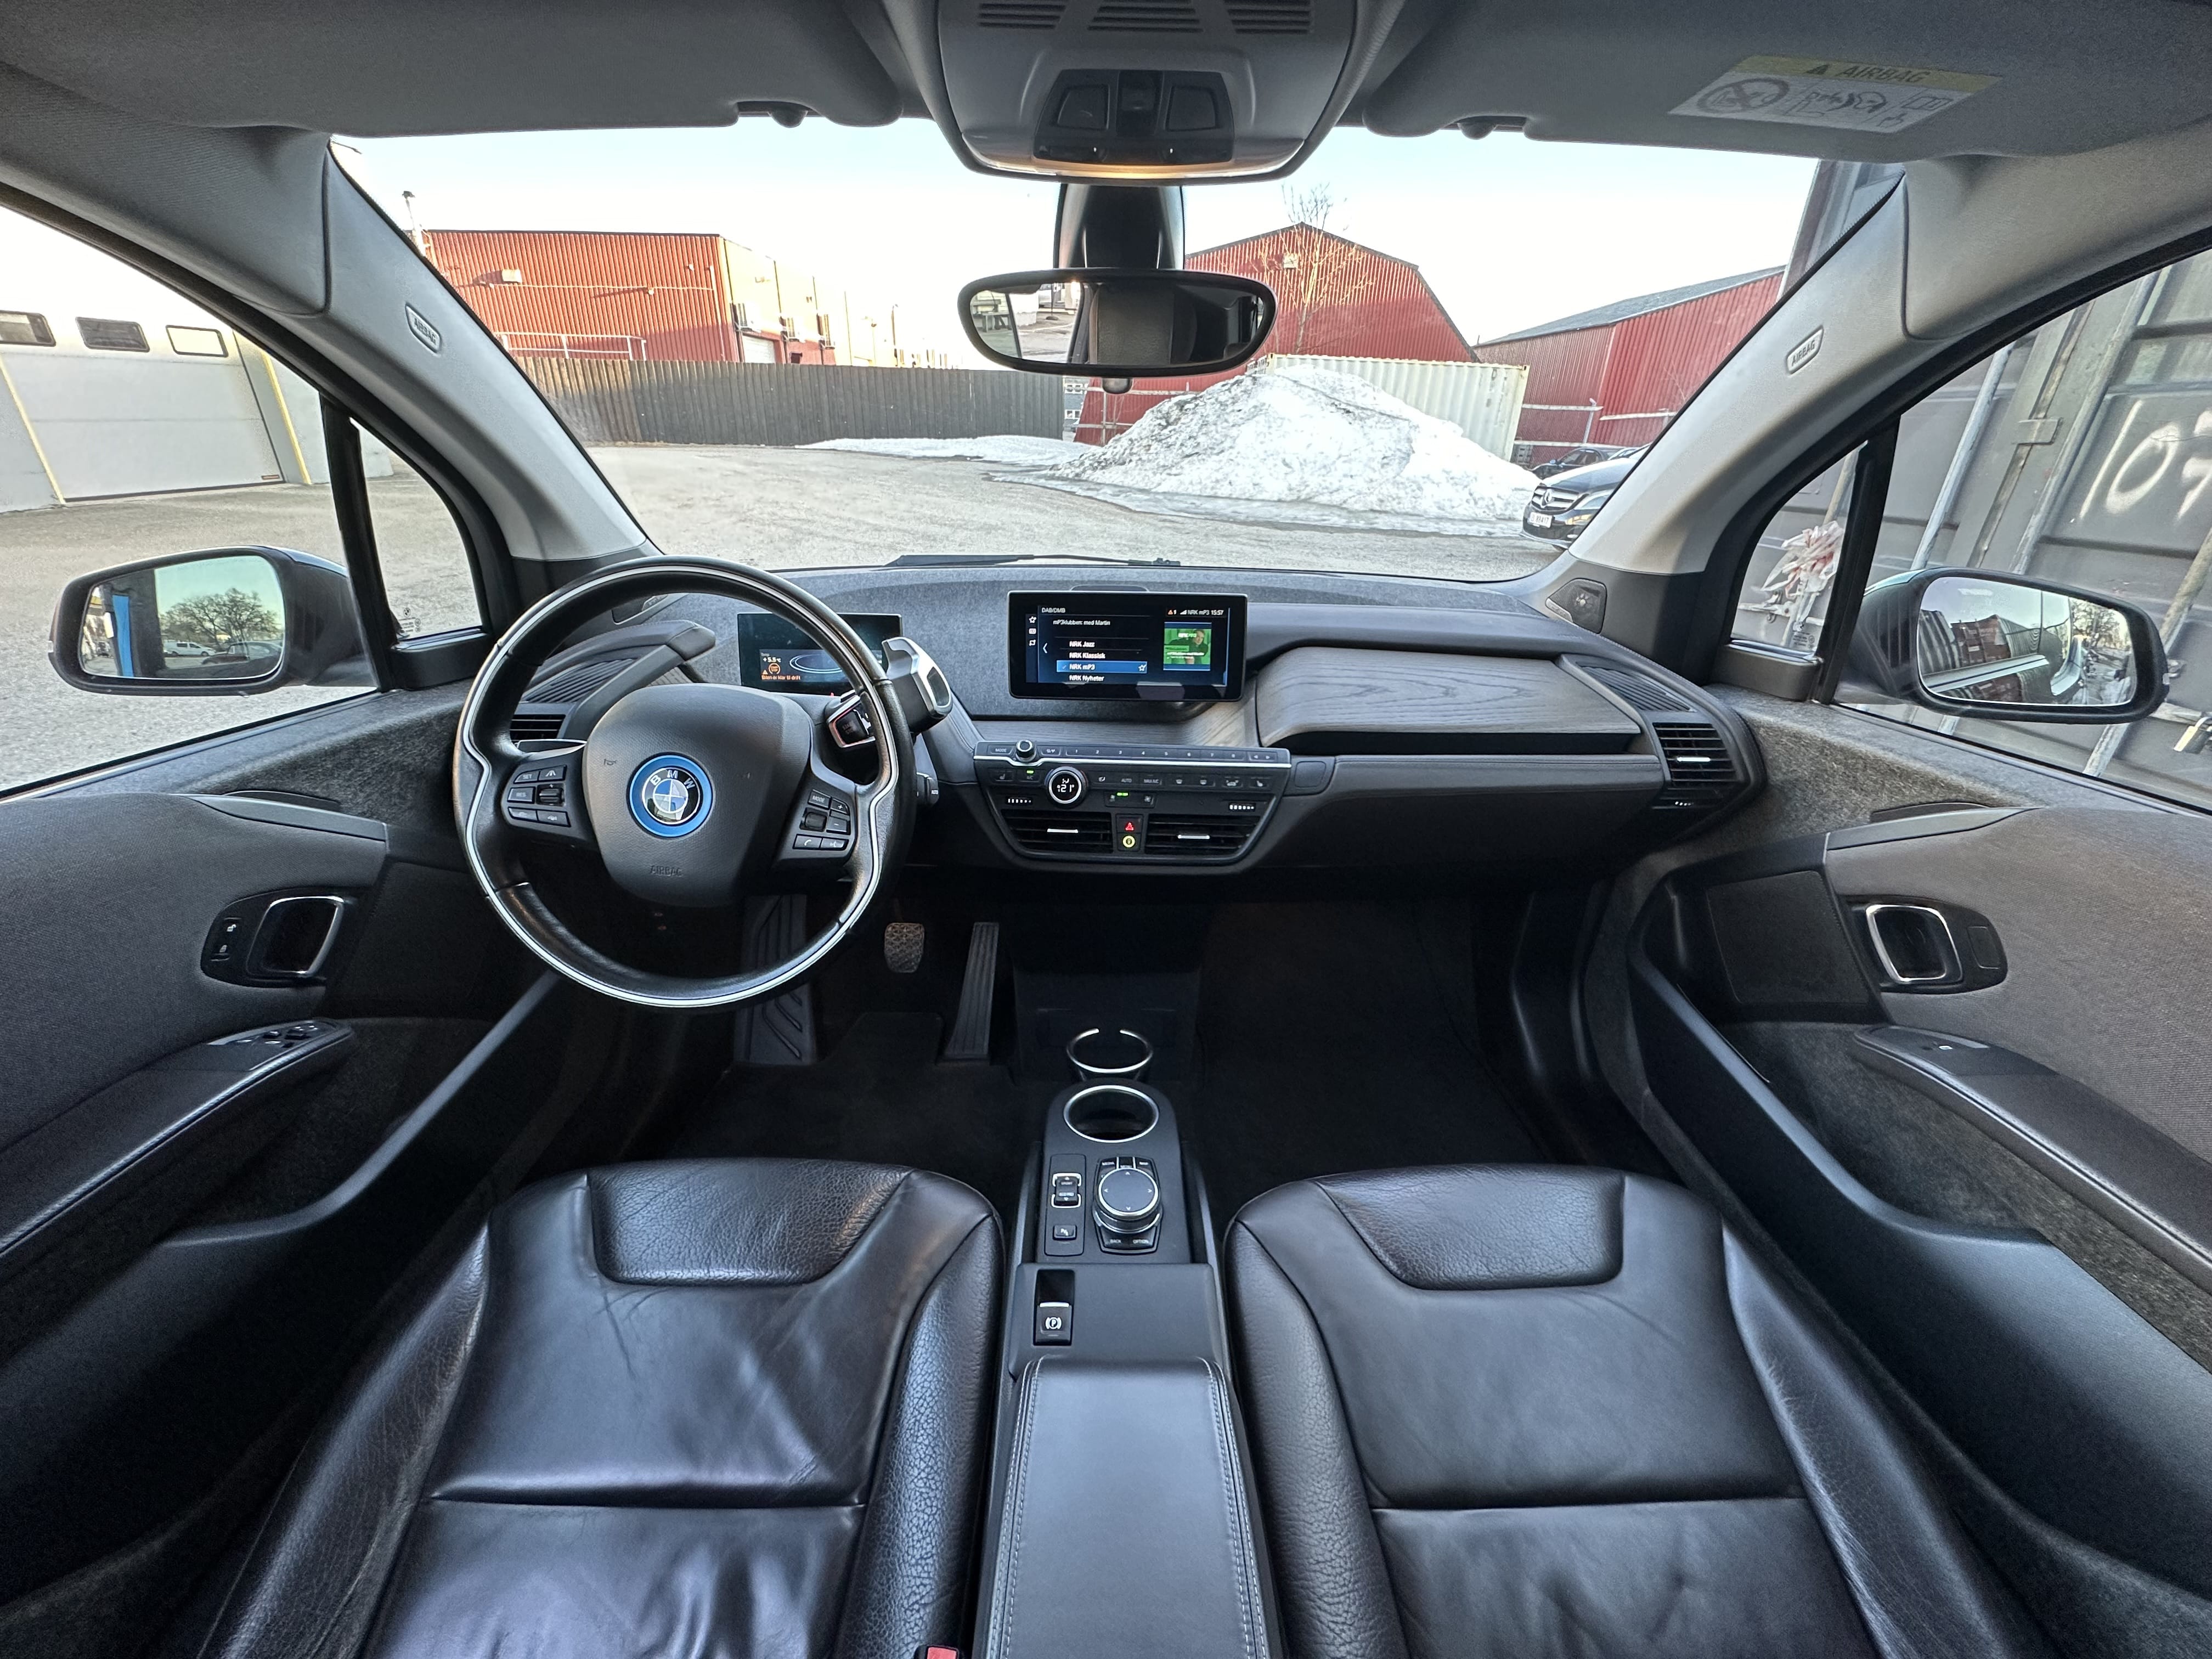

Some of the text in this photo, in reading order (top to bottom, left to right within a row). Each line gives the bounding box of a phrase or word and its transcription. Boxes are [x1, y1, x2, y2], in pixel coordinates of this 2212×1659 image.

[1835, 66, 1931, 82] AIRBAG
[414, 318, 436, 345] AIRBAG
[1791, 340, 1815, 366] AIRBAG
[650, 770, 696, 789] BMW
[812, 795, 826, 803] MODE
